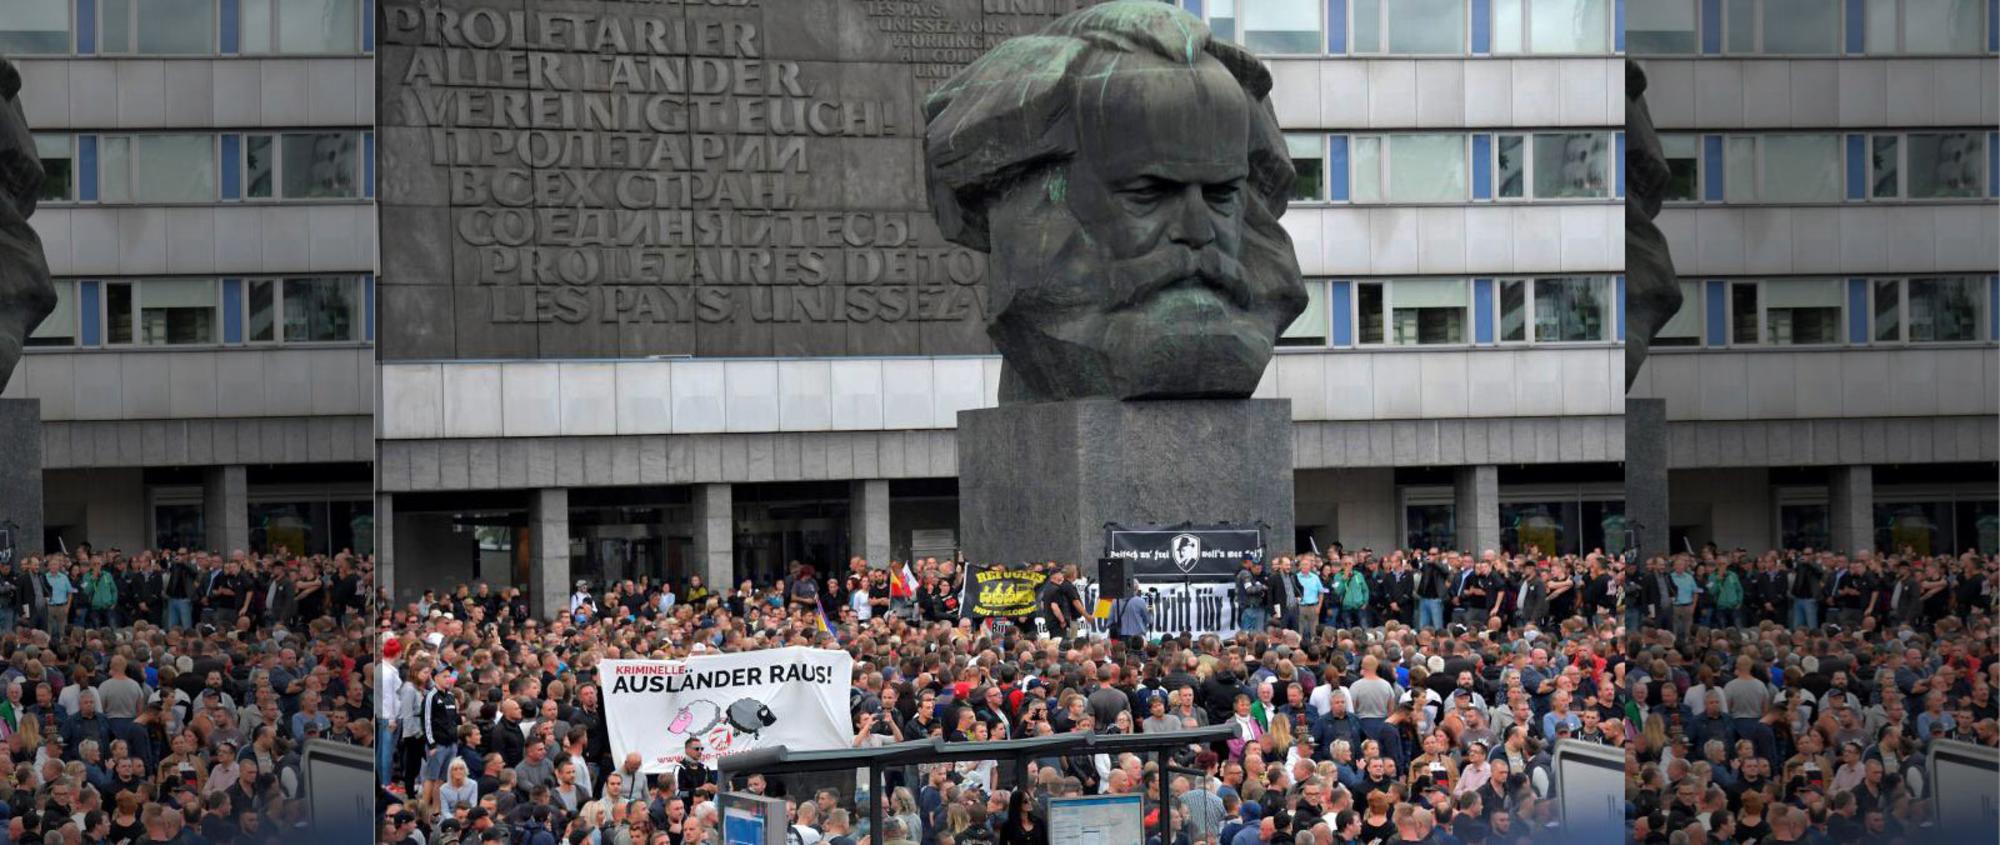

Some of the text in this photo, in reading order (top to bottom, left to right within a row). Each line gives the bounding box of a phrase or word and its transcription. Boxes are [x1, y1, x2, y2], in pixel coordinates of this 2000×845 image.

[382, 7, 761, 58] PROLETARIER
[402, 49, 568, 91] ALLER
[404, 87, 898, 137] VEREINIGT EUCH!
[432, 127, 808, 173] ПРОЛЕТАРИИ
[450, 168, 604, 209] ВСЕХ
[479, 246, 830, 287] PROLETAIRES
[490, 285, 594, 325] LES
[976, 569, 1047, 584] REFUGEES
[612, 663, 832, 694] AUSLÄNDER RAUS!
[616, 665, 686, 675] KRIMINELLE
